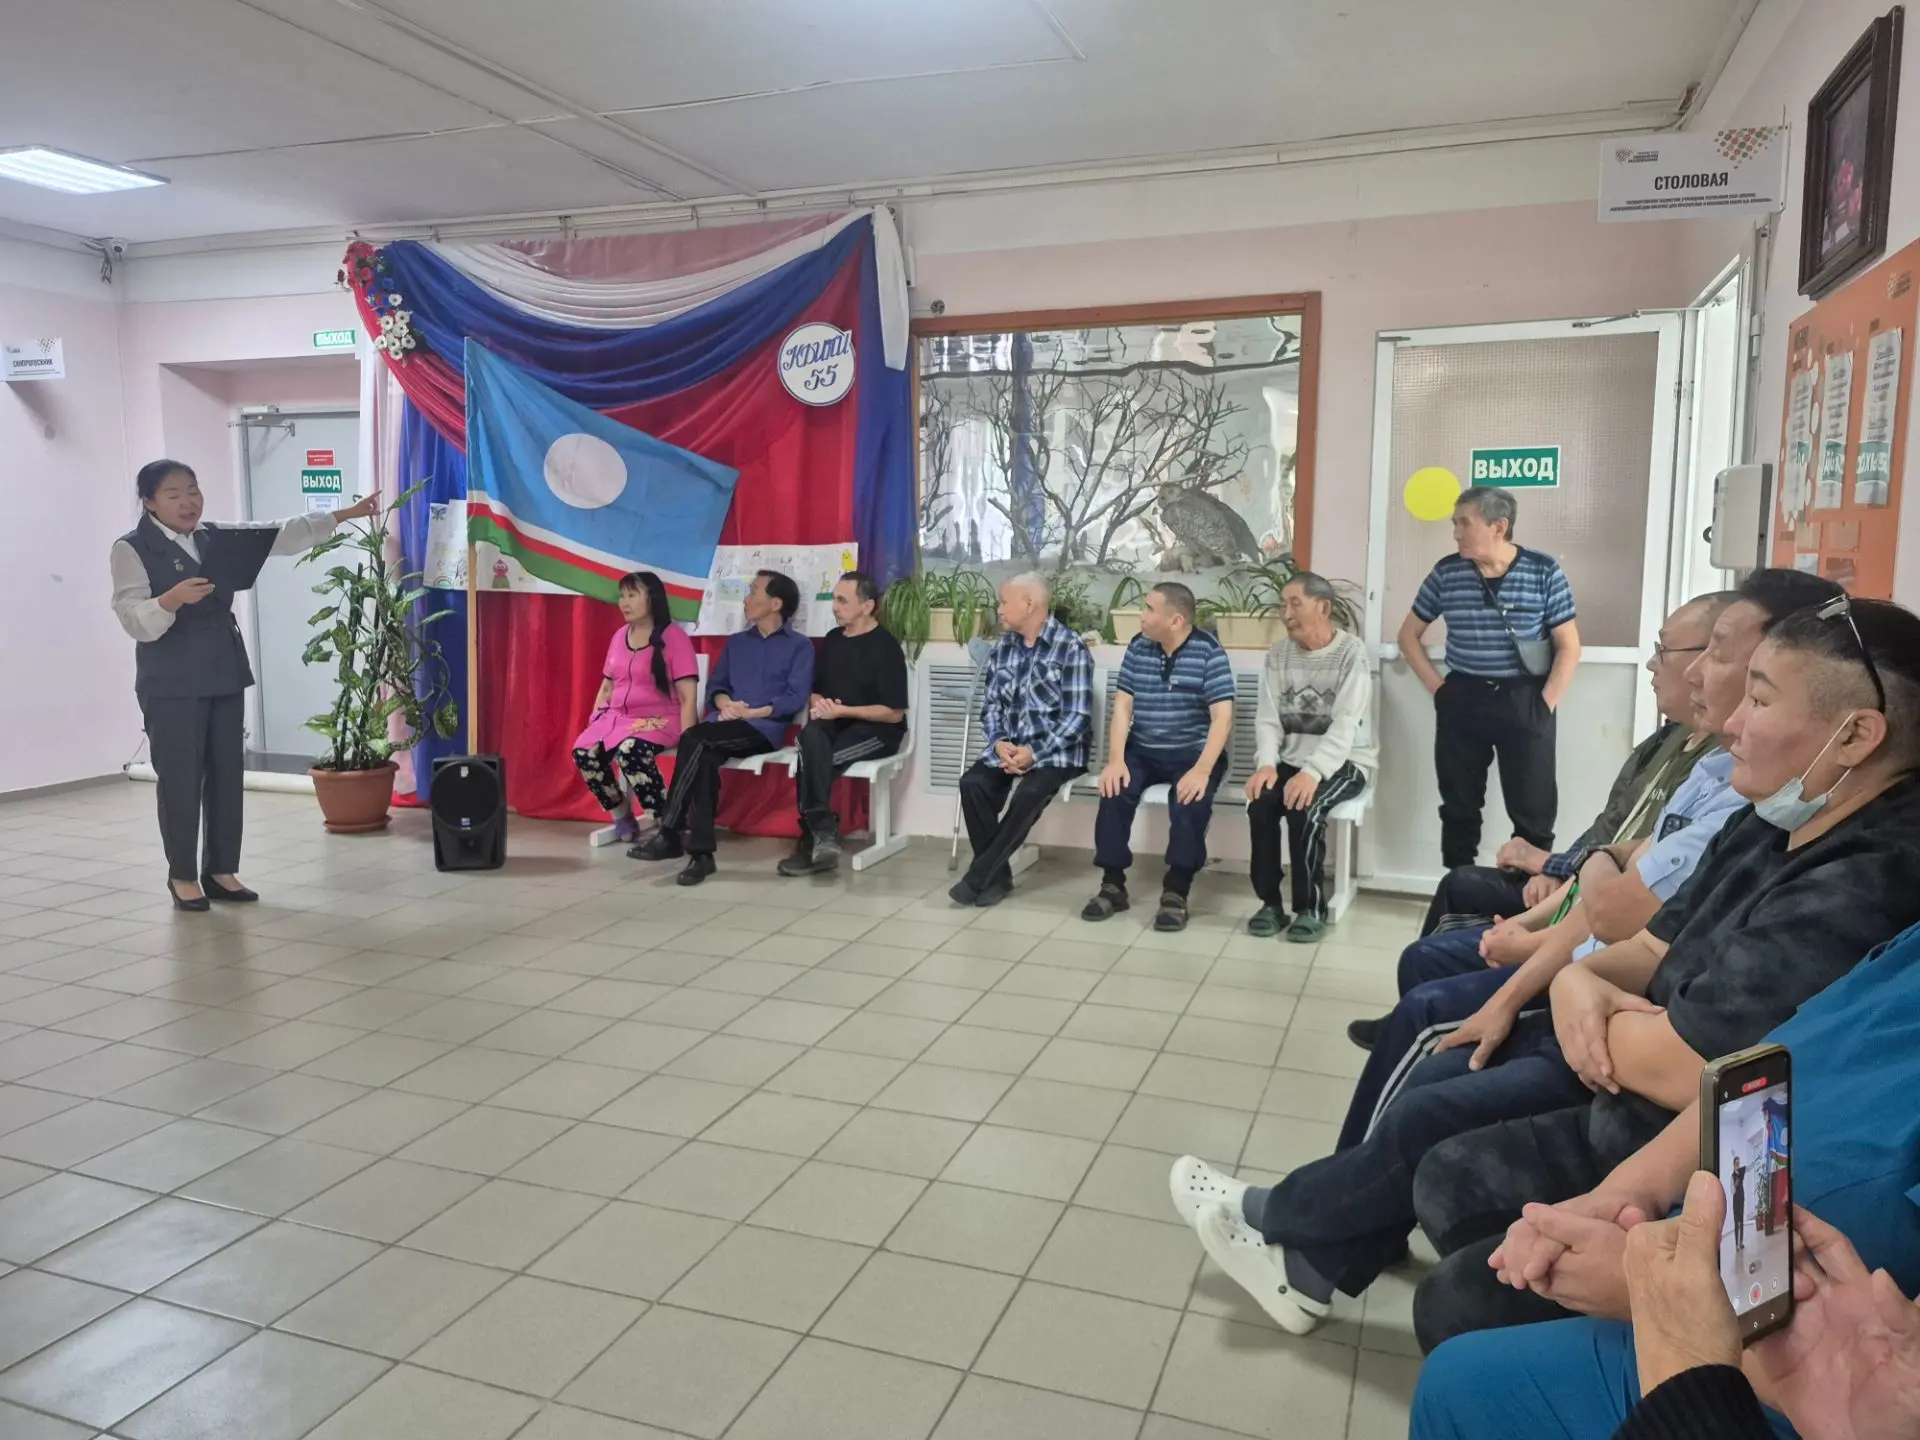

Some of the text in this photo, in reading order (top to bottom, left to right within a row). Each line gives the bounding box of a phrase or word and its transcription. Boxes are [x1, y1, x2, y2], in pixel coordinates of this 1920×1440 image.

[1654, 172, 1729, 191] СТОЛОВАЯ
[316, 331, 353, 345] ВЫХОД
[803, 363, 839, 391] 55
[1474, 457, 1554, 481] ВЫХОД
[302, 474, 341, 491] ВЫХОД
